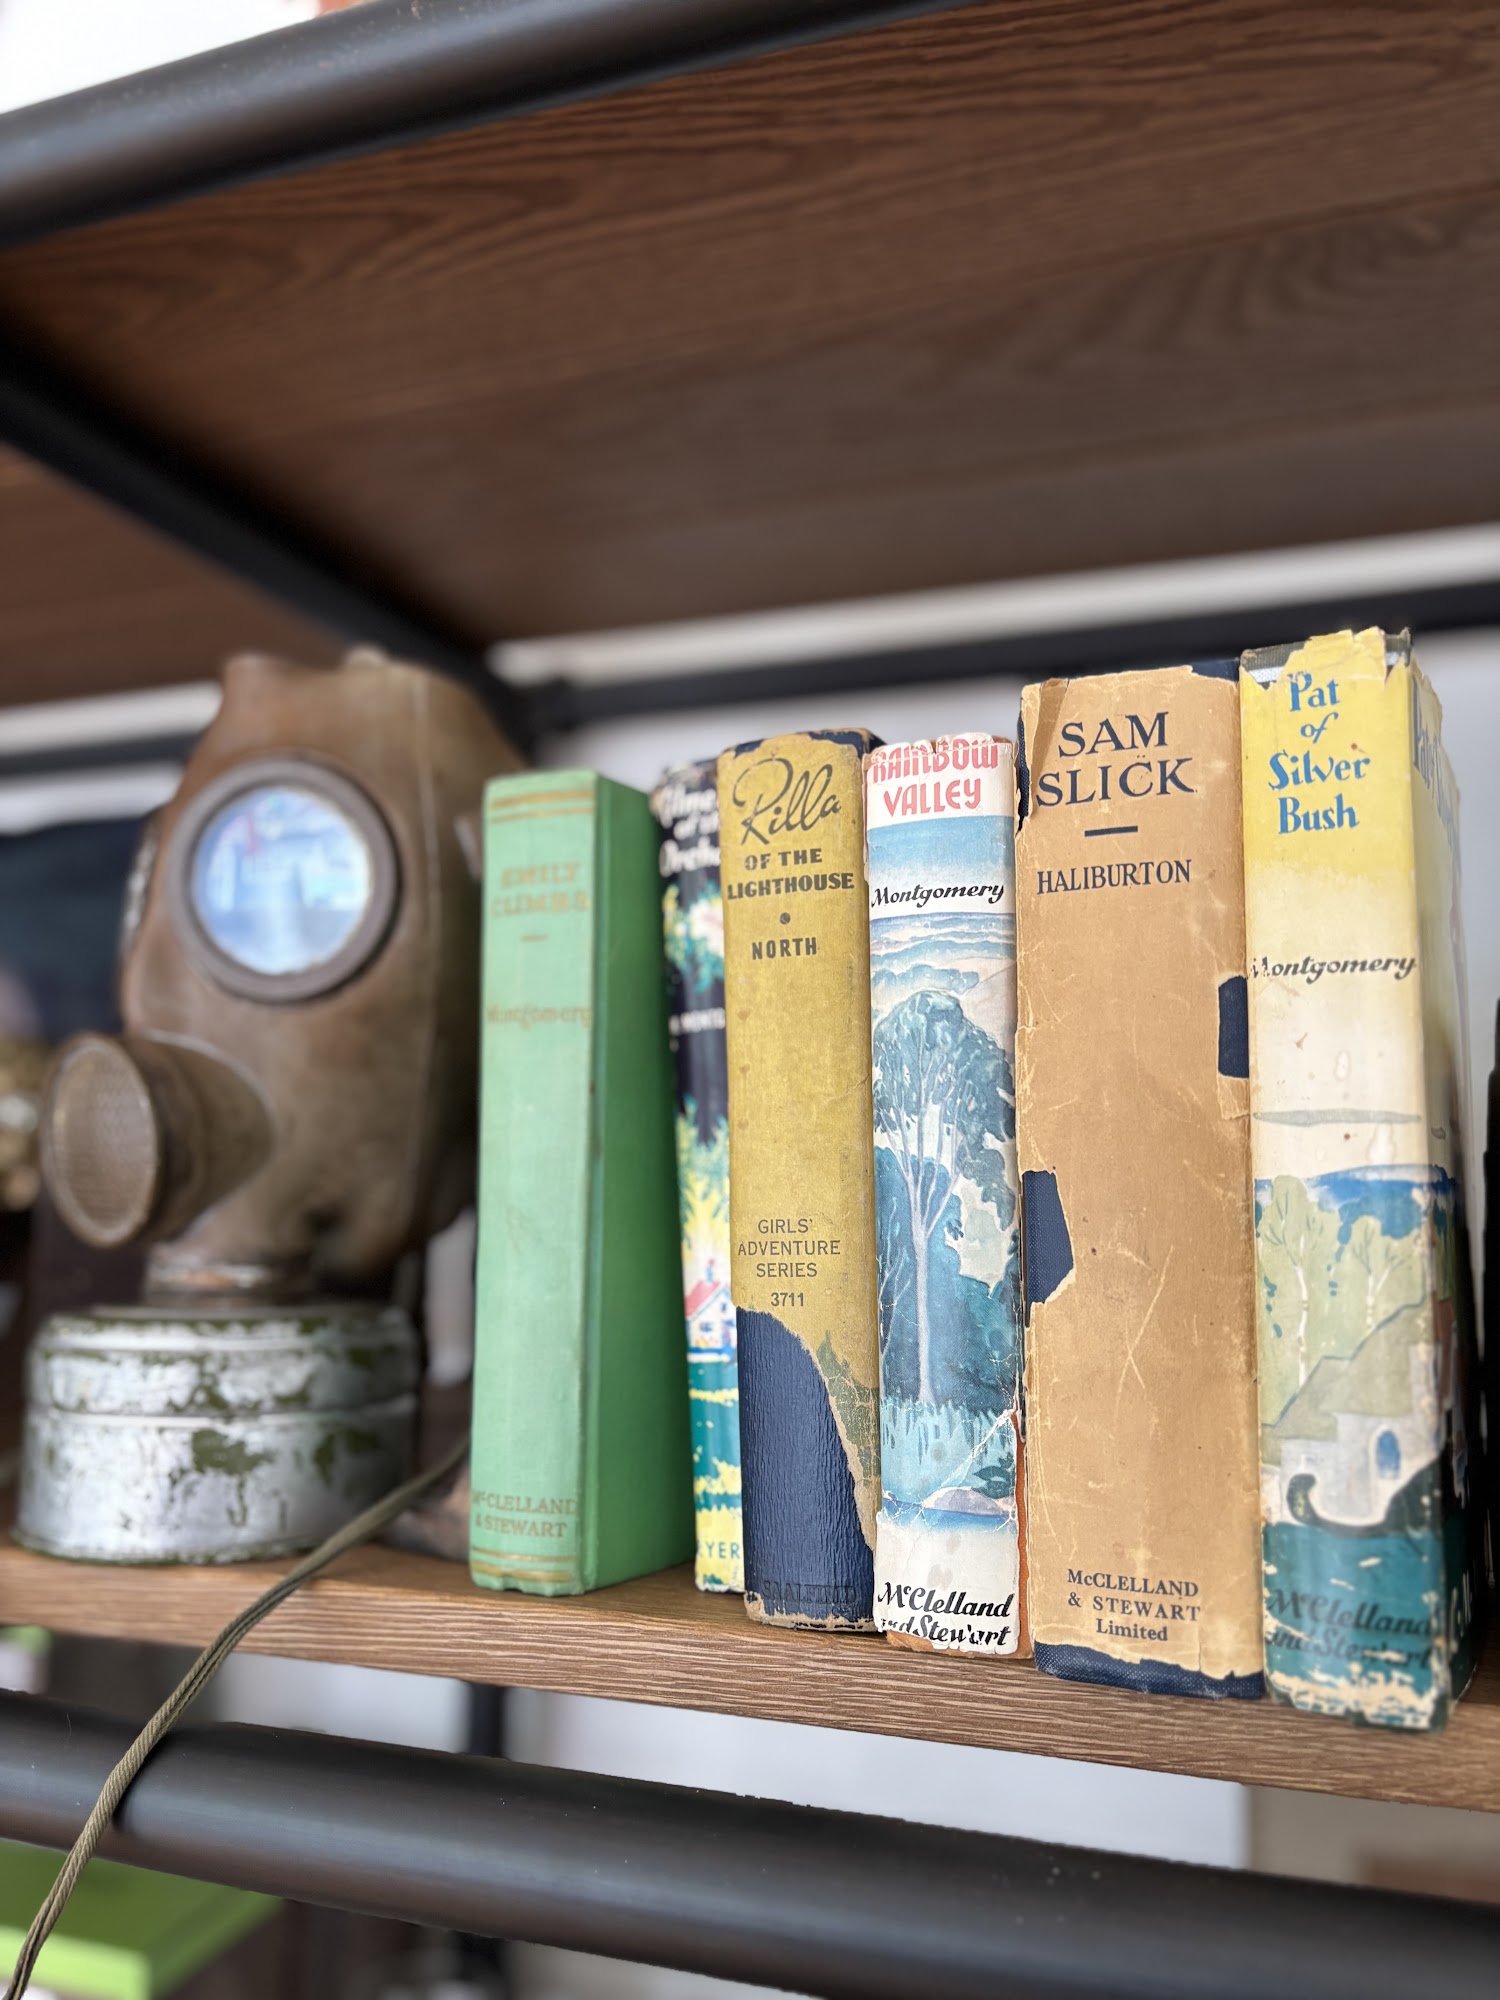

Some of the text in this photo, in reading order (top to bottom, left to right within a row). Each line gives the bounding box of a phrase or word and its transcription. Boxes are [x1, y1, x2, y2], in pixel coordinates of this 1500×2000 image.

[1288, 671, 1341, 713] Pat
[1057, 711, 1169, 758] SAM
[1299, 711, 1339, 744] of
[872, 738, 999, 784] RAINBOW
[1267, 748, 1371, 791] Silver
[1035, 757, 1195, 807] SLICK
[732, 757, 842, 846] Rilla
[883, 777, 982, 818] VALLEY
[1277, 793, 1360, 835] Bush
[744, 847, 823, 871] OF THE
[501, 863, 582, 890] EMILY
[727, 872, 855, 900] LIGHTHOUSE
[1036, 859, 1193, 895] HALIBURTON
[491, 891, 591, 919] CLIMBS
[871, 883, 1004, 908] Montgomery
[751, 936, 818, 961] NORTH
[757, 1218, 813, 1235] GIRLS'
[737, 1240, 841, 1256] ADVENTURE
[756, 1262, 818, 1278] SERIES
[770, 1292, 804, 1307] 3711
[484, 1514, 569, 1538] STEWART
[1067, 1568, 1200, 1598] McCLELLAND
[877, 1581, 1016, 1618] McClelland
[1067, 1592, 1201, 1622] & STEWART
[1095, 1618, 1169, 1642] Limited
